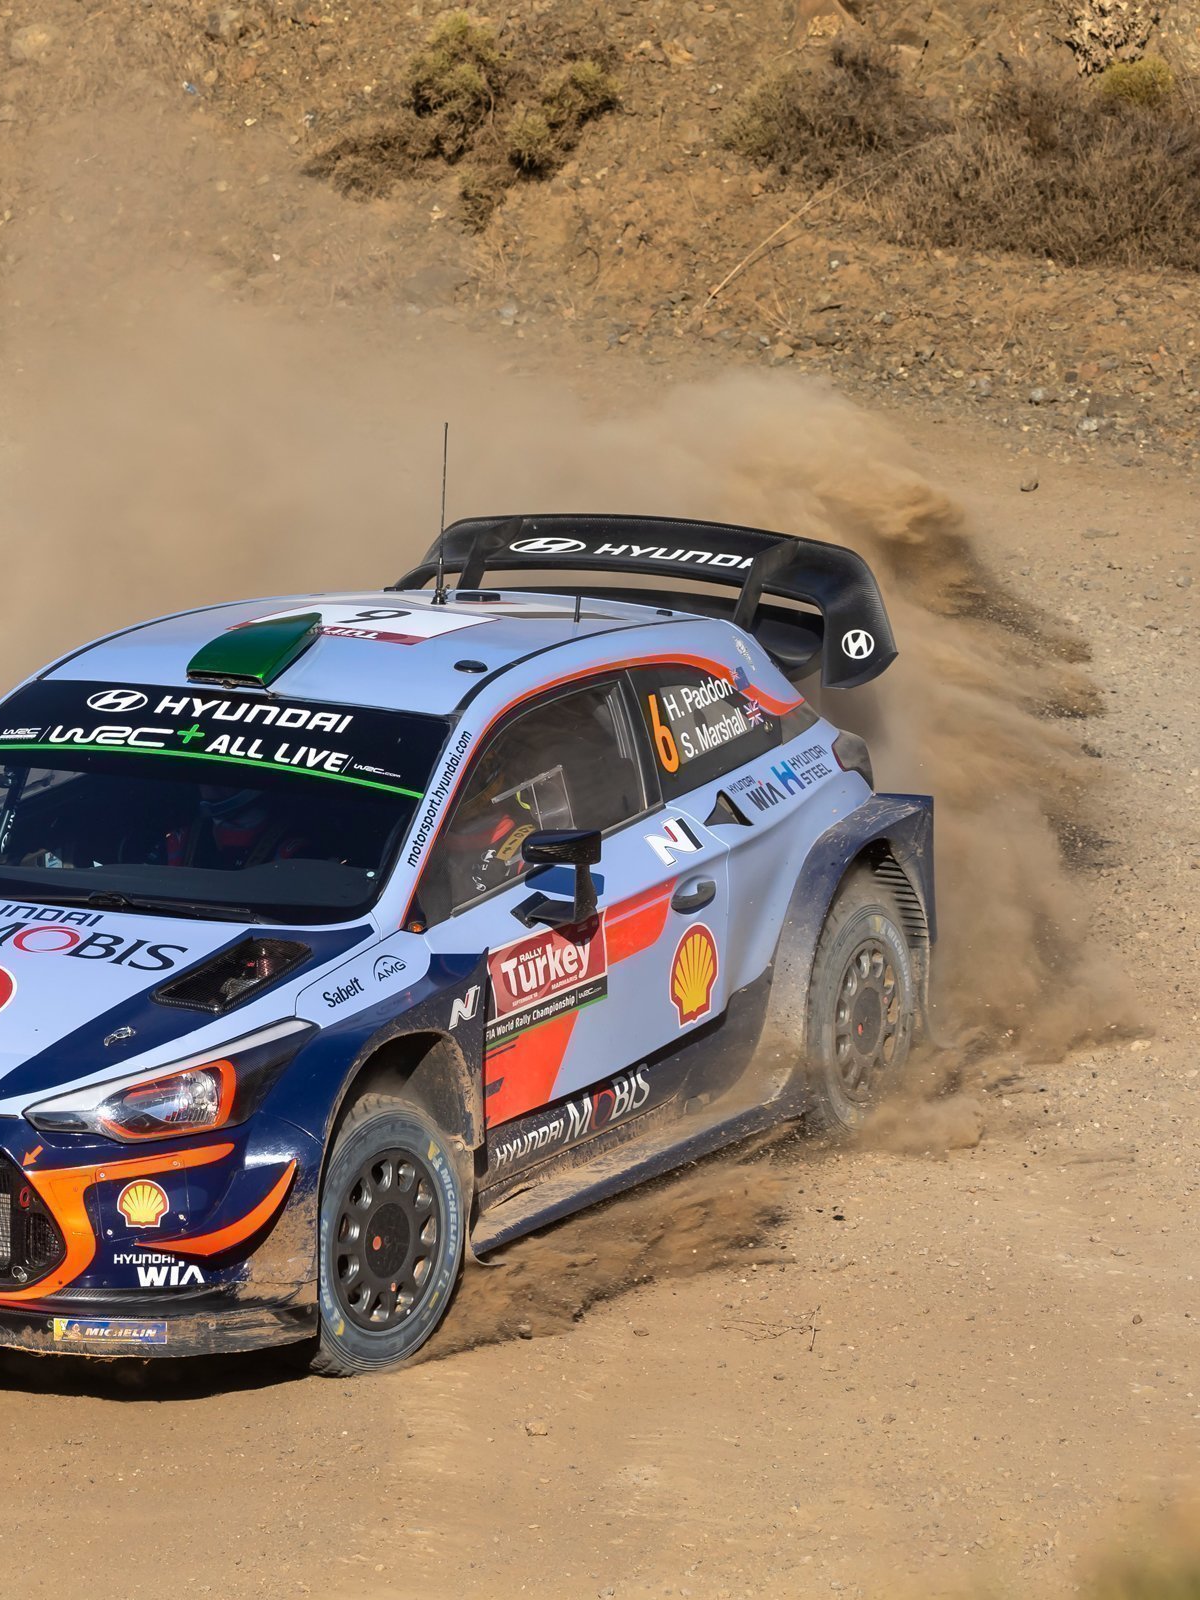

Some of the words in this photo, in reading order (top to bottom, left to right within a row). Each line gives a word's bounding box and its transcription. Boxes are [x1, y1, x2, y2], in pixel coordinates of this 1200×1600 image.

[593, 543, 755, 569] HYUND
[154, 695, 353, 734] HYUNDAI
[662, 696, 686, 721] H.
[680, 677, 733, 713] Paddon
[648, 694, 681, 773] 6
[680, 732, 699, 759] S.
[695, 708, 748, 749] Marshall
[204, 734, 263, 760] ALL
[274, 745, 349, 773] LIVE
[790, 744, 828, 771] HYUNDAI
[726, 774, 757, 795] HYUNDAI
[800, 763, 832, 785] STEEL
[406, 730, 472, 868] motorsport.hyundai.com
[746, 781, 786, 811] WIA
[500, 938, 591, 997] Turkey
[519, 946, 543, 963] RALLY
[377, 961, 407, 982] AMG
[551, 974, 578, 990] MARMARIS
[322, 977, 365, 1008] Sabelt
[496, 1020, 514, 1036] World
[515, 1012, 531, 1028] Rally
[532, 994, 575, 1021] Championship
[564, 1063, 650, 1144] MOBIS
[495, 1117, 565, 1169] HYUNDAI
[439, 1168, 459, 1257] MICHELIN
[113, 1254, 175, 1264] HYUNDAI
[137, 1261, 205, 1287] WIA
[85, 1327, 157, 1337] MICHELIN
